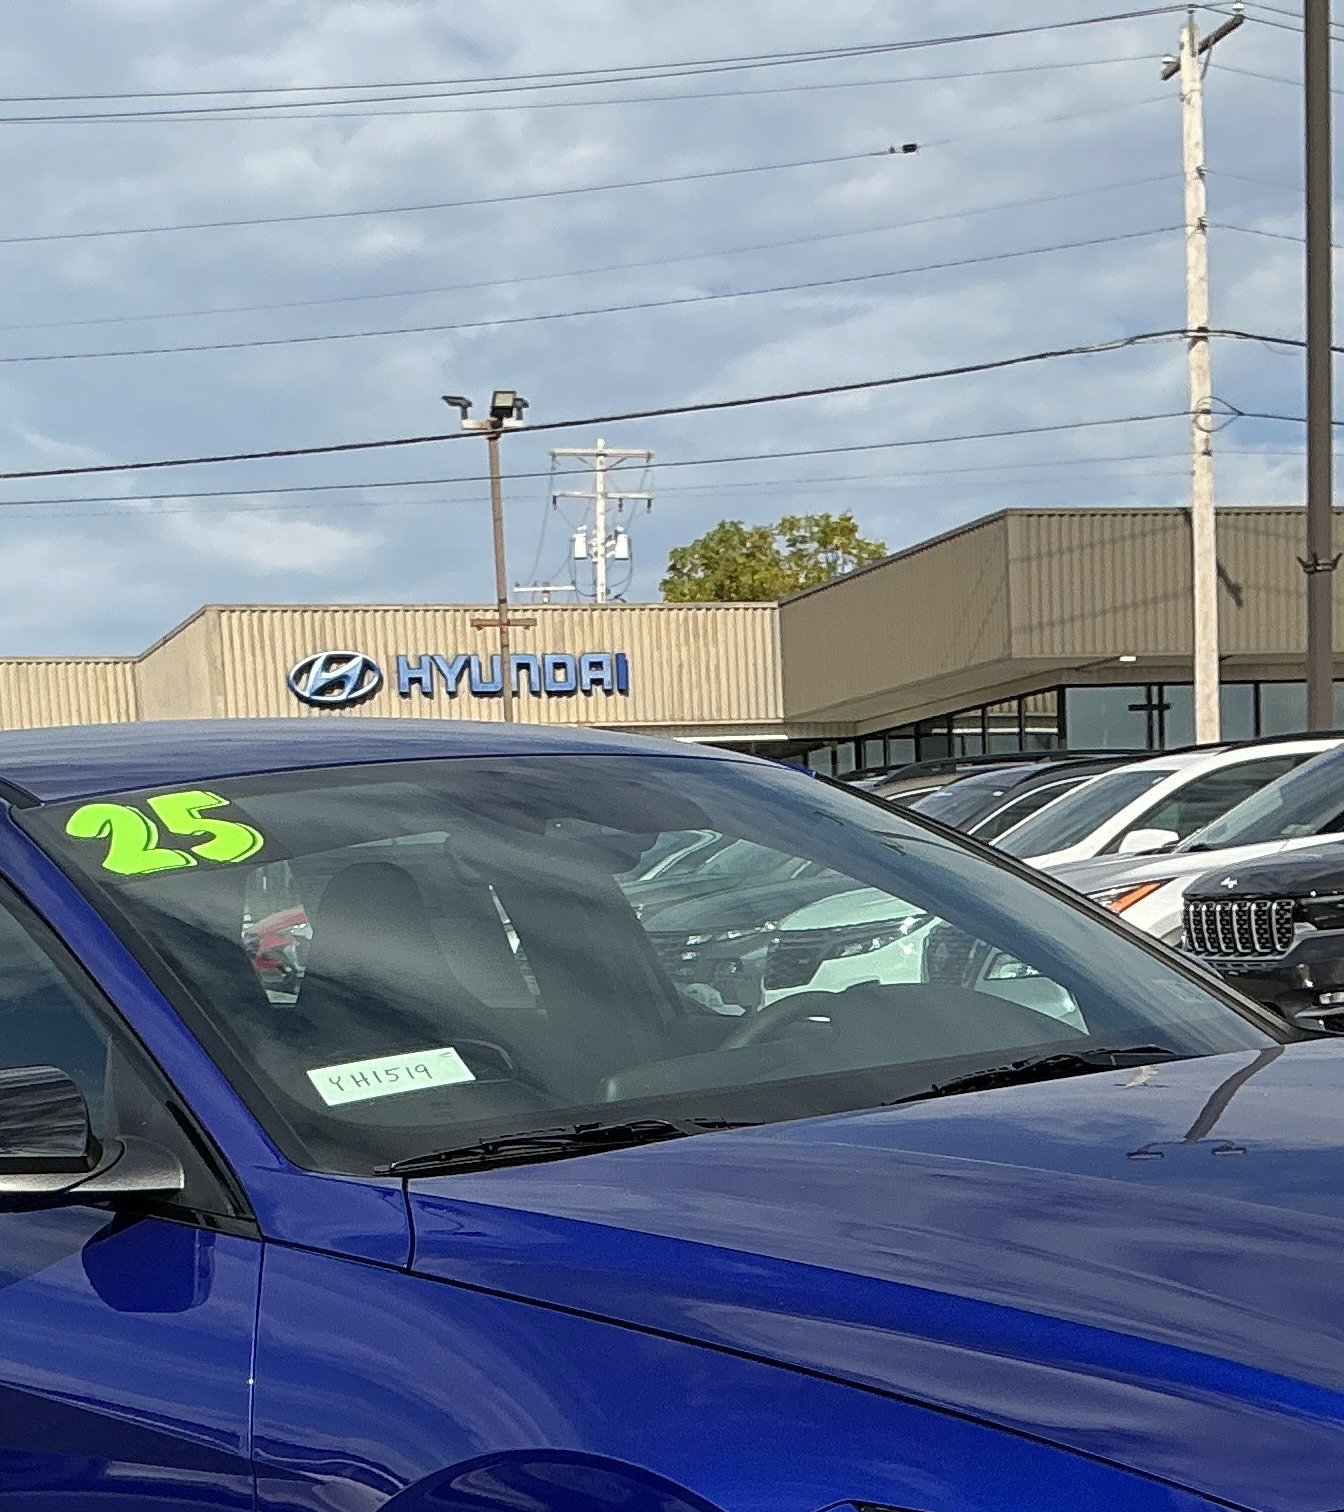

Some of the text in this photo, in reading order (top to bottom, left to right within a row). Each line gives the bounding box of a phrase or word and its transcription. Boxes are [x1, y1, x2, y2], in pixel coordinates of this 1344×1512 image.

[397, 652, 629, 697] HYUNDAI
[65, 790, 265, 876] 25
[328, 1063, 433, 1092] YH1519
